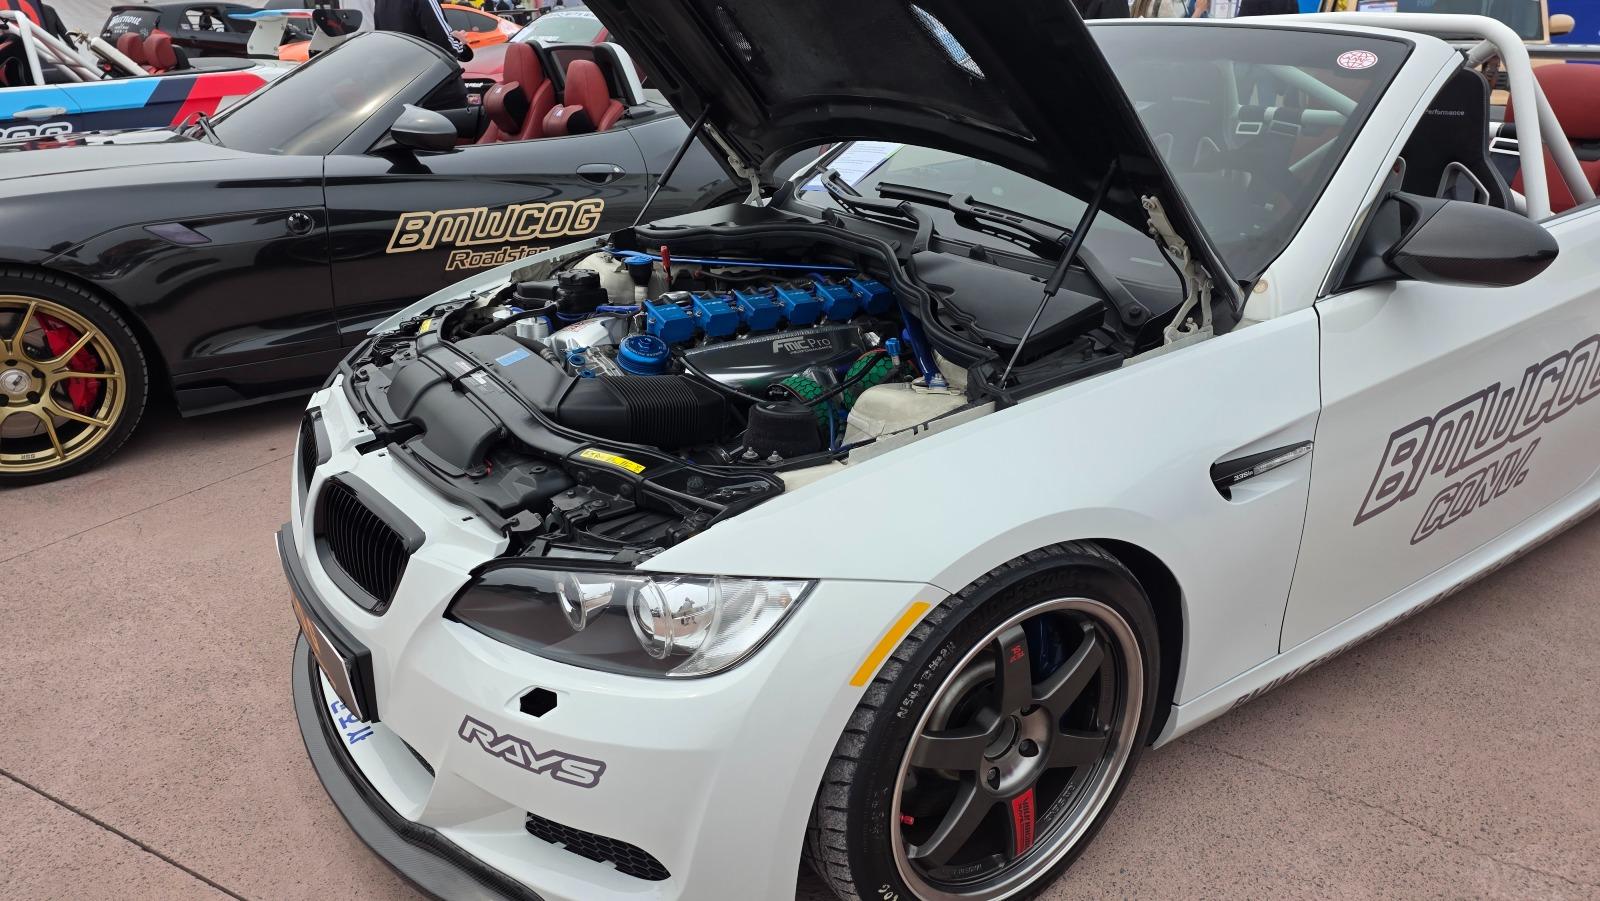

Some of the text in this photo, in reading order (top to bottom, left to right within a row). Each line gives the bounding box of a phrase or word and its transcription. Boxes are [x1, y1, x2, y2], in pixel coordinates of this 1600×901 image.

[386, 199, 605, 253] BMWCOG
[807, 338, 831, 349] Pro
[1353, 333, 1600, 526] BMWCO
[1410, 436, 1542, 545] CONV.
[458, 714, 607, 789] RAYS
